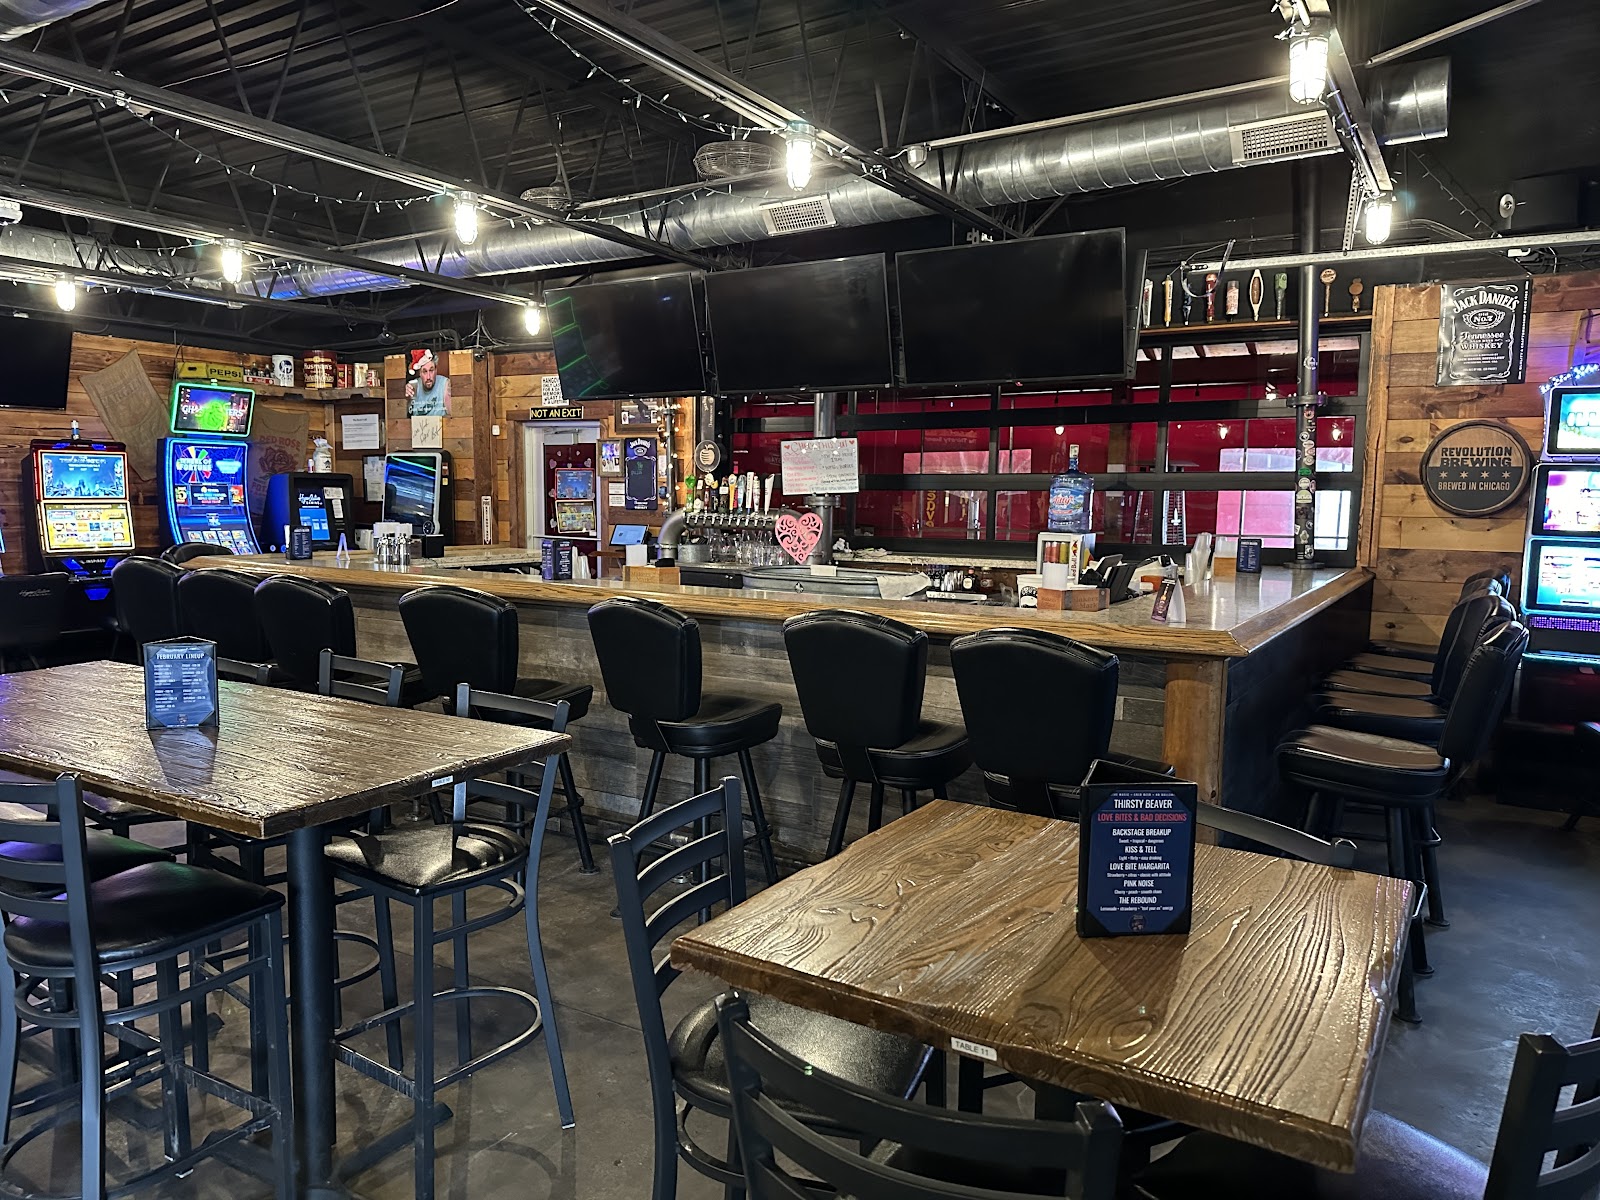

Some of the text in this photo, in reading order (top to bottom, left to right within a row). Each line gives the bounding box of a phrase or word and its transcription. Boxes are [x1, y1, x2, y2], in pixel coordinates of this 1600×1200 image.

[1453, 290, 1519, 313] JACK DANIEL'S
[1460, 332, 1505, 340] Tennessee
[1461, 342, 1504, 350] WHISKEY
[209, 368, 242, 378] PEPSI
[531, 408, 582, 418] NOT AN EXIT
[260, 435, 301, 451] RED ROSE
[1441, 446, 1513, 457] REVOLUTION
[1440, 457, 1512, 467] BREWING
[1438, 481, 1510, 491] BREWED IN CHICAGO
[1114, 799, 1173, 809] THIRSTY BEAVER
[1097, 812, 1187, 822] LOVE BITES & BAD DECISIONS
[1112, 828, 1172, 836] BACKSTAGE BREAKUP
[1124, 845, 1157, 854] KISS & TELL
[1110, 862, 1170, 871] LOVE BITE MARGARITA
[1123, 879, 1155, 888] PINK NOISE
[1119, 896, 1157, 904] THE REBOUND
[955, 1040, 989, 1056] TABLE 11
